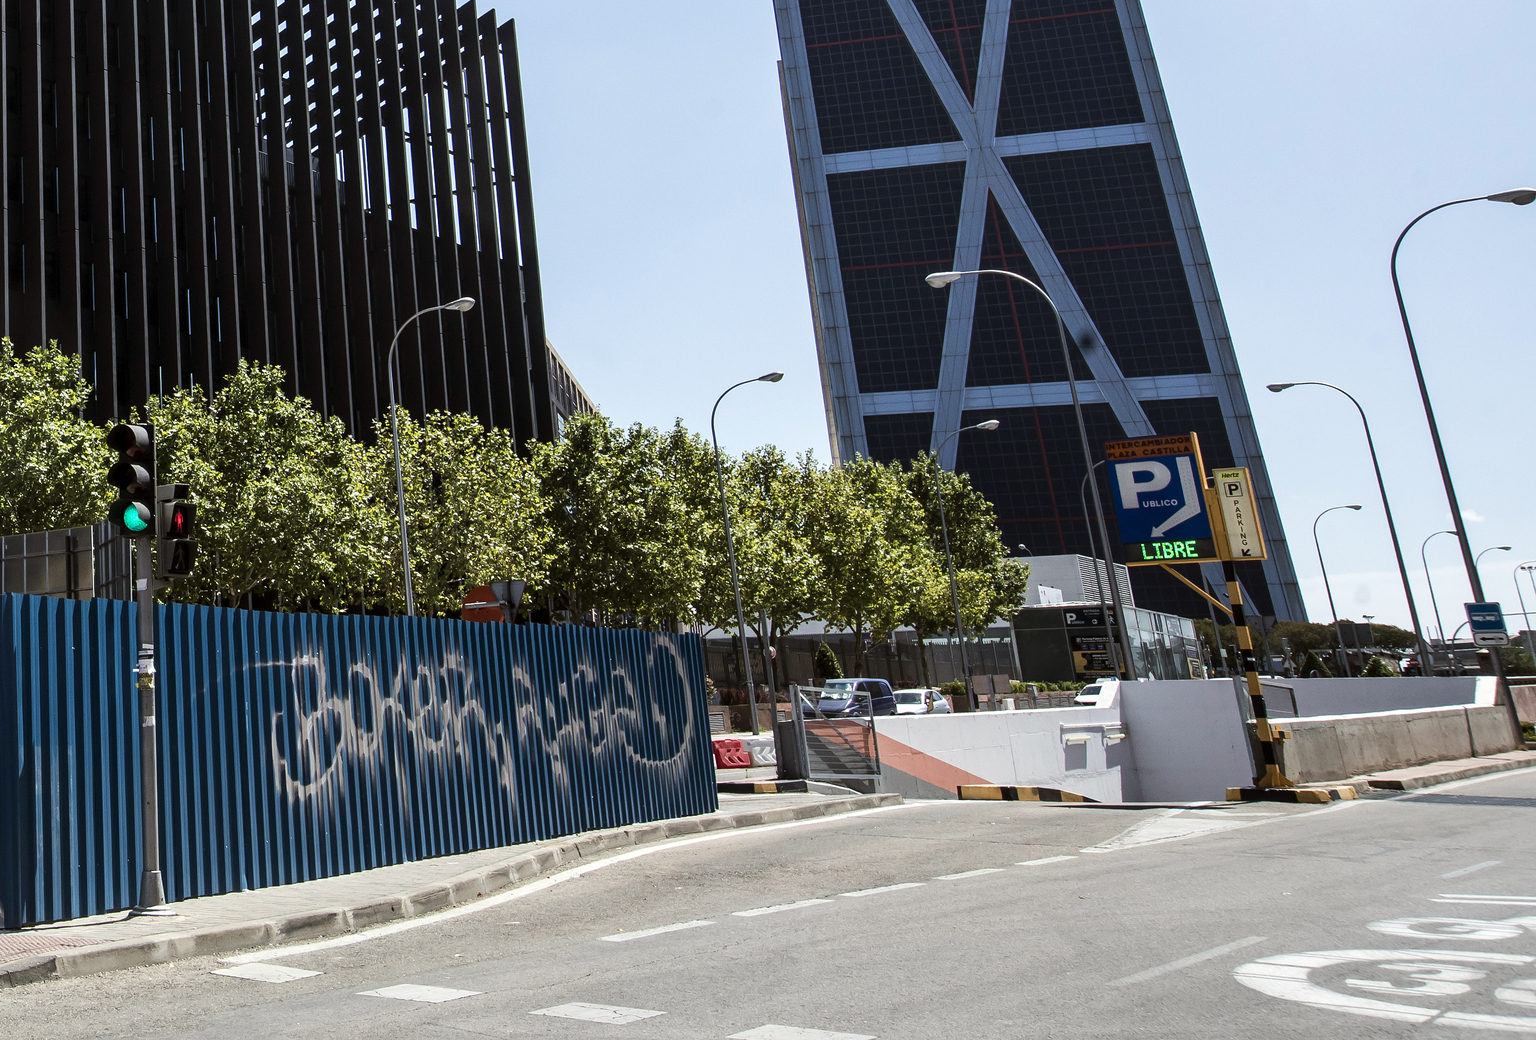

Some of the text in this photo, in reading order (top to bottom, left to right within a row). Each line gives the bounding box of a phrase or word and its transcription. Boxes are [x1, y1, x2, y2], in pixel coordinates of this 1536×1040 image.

[1105, 436, 1191, 451] INTERCAMBIADOR
[1107, 446, 1190, 460] PLAZA CASTILLA
[1228, 484, 1239, 495] P
[1233, 500, 1248, 546] PARKING
[1140, 541, 1198, 560] LIBRE
